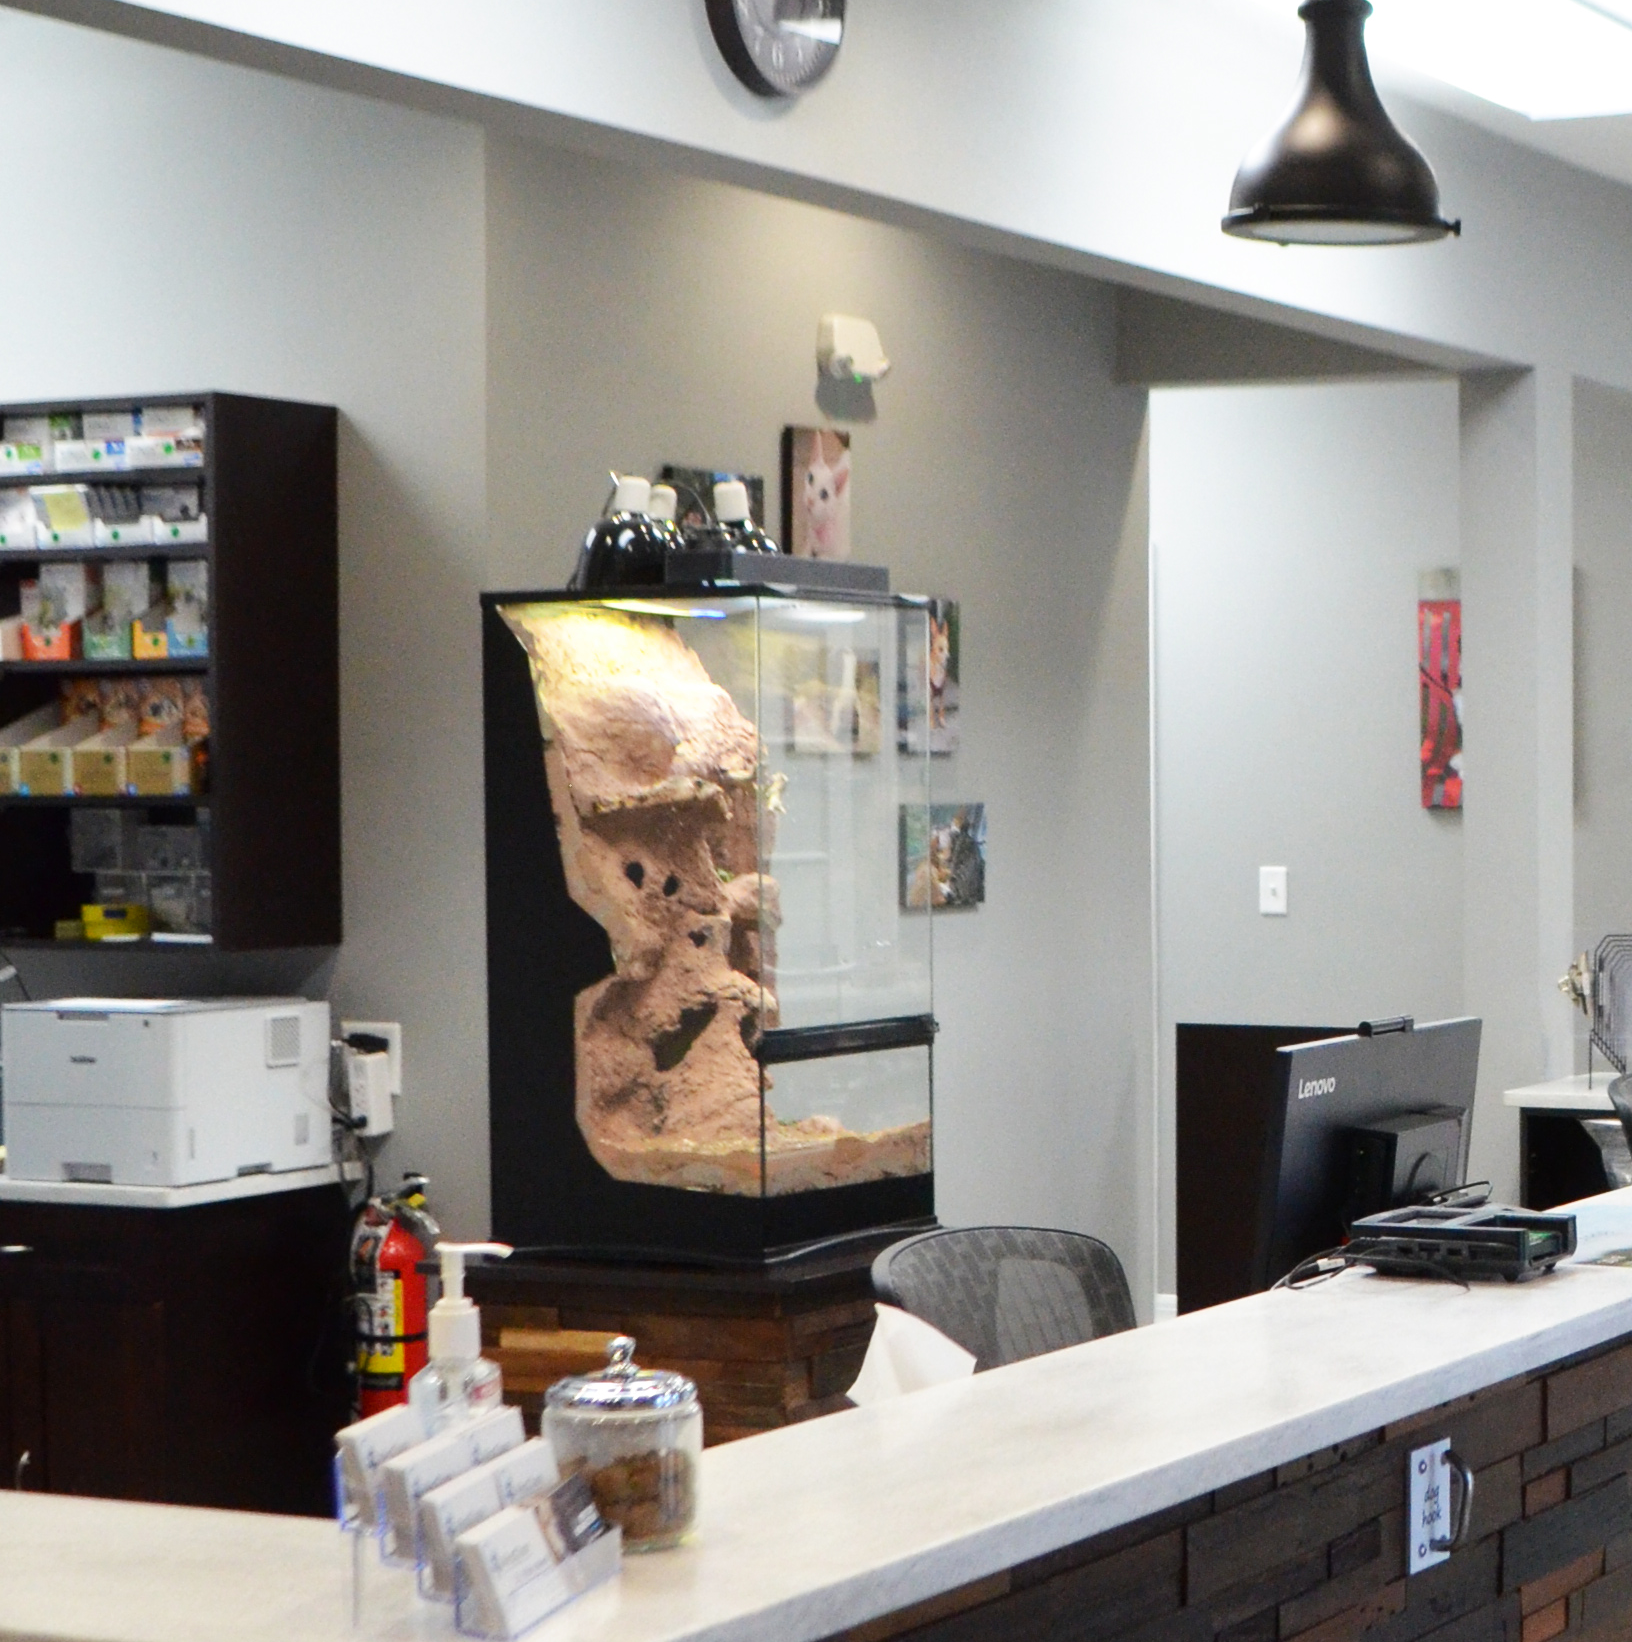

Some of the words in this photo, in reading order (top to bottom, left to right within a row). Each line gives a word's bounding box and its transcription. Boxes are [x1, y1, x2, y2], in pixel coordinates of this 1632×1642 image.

[1298, 1076, 1335, 1100] Lenovo
[1424, 1483, 1439, 1508] dog
[1421, 1509, 1441, 1528] hook
